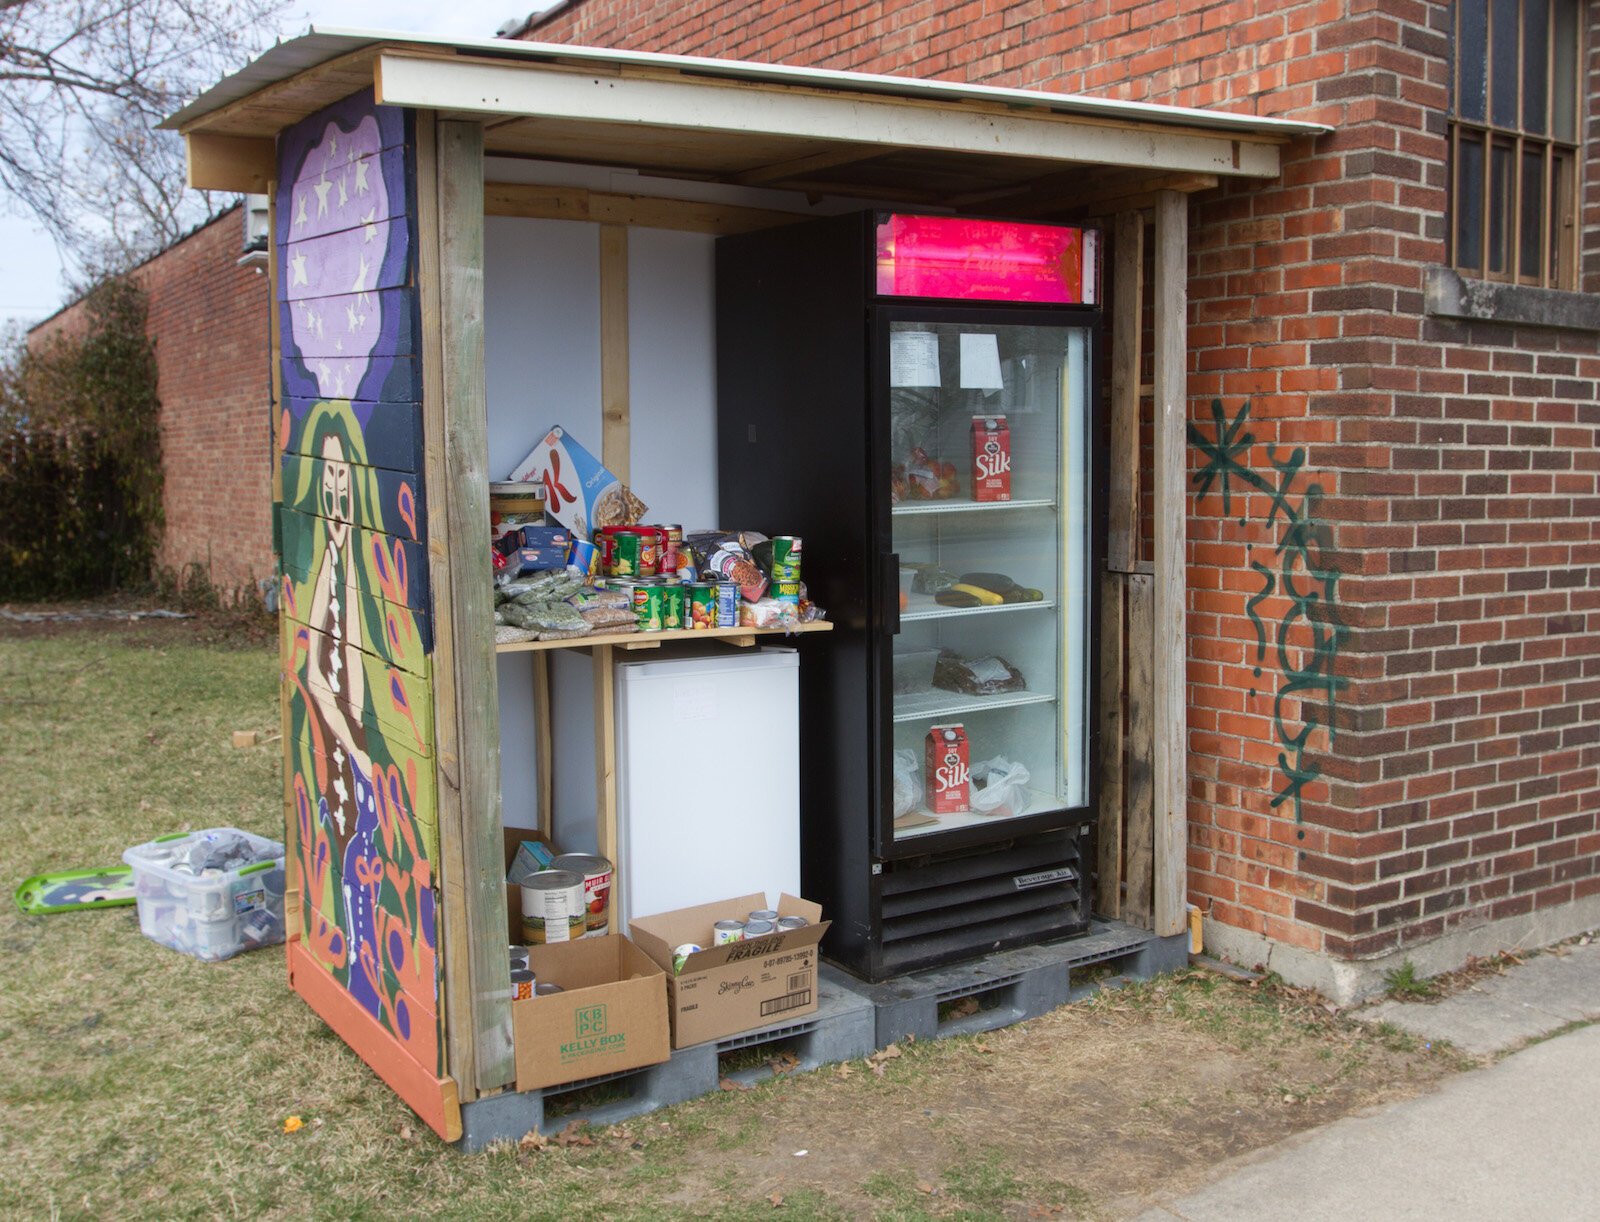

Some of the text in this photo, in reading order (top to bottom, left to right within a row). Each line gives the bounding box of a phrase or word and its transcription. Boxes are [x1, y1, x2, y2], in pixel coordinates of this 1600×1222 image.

[976, 451, 1010, 480] Silk
[935, 762, 970, 793] Silk
[726, 941, 783, 963] FRAGILE
[560, 1033, 625, 1054] KELLY BOX
